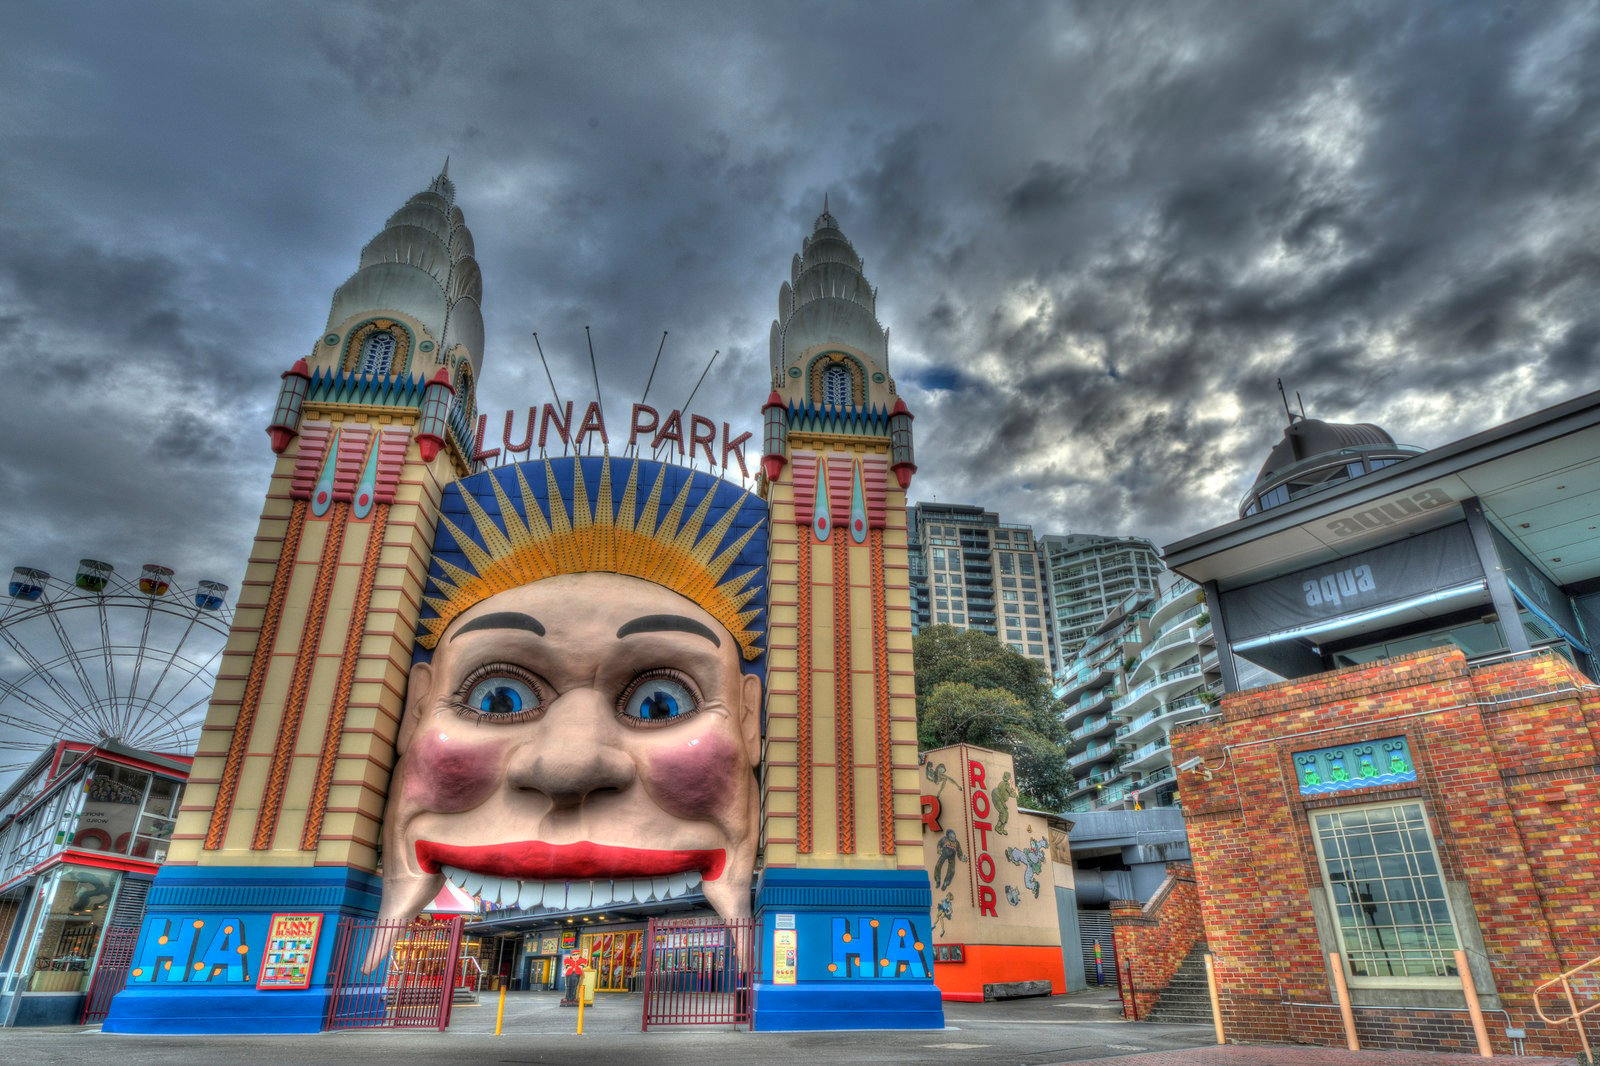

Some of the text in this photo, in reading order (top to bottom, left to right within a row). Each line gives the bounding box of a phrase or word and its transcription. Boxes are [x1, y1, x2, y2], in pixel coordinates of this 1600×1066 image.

[472, 401, 753, 478] LUNA PARK
[1326, 487, 1454, 537] aqua
[1302, 564, 1376, 607] aqua
[968, 759, 999, 918] ROTOR
[134, 917, 249, 982] HA
[275, 929, 313, 937] BUSINESS
[277, 920, 316, 930] FUNNY
[829, 916, 932, 979] HA
